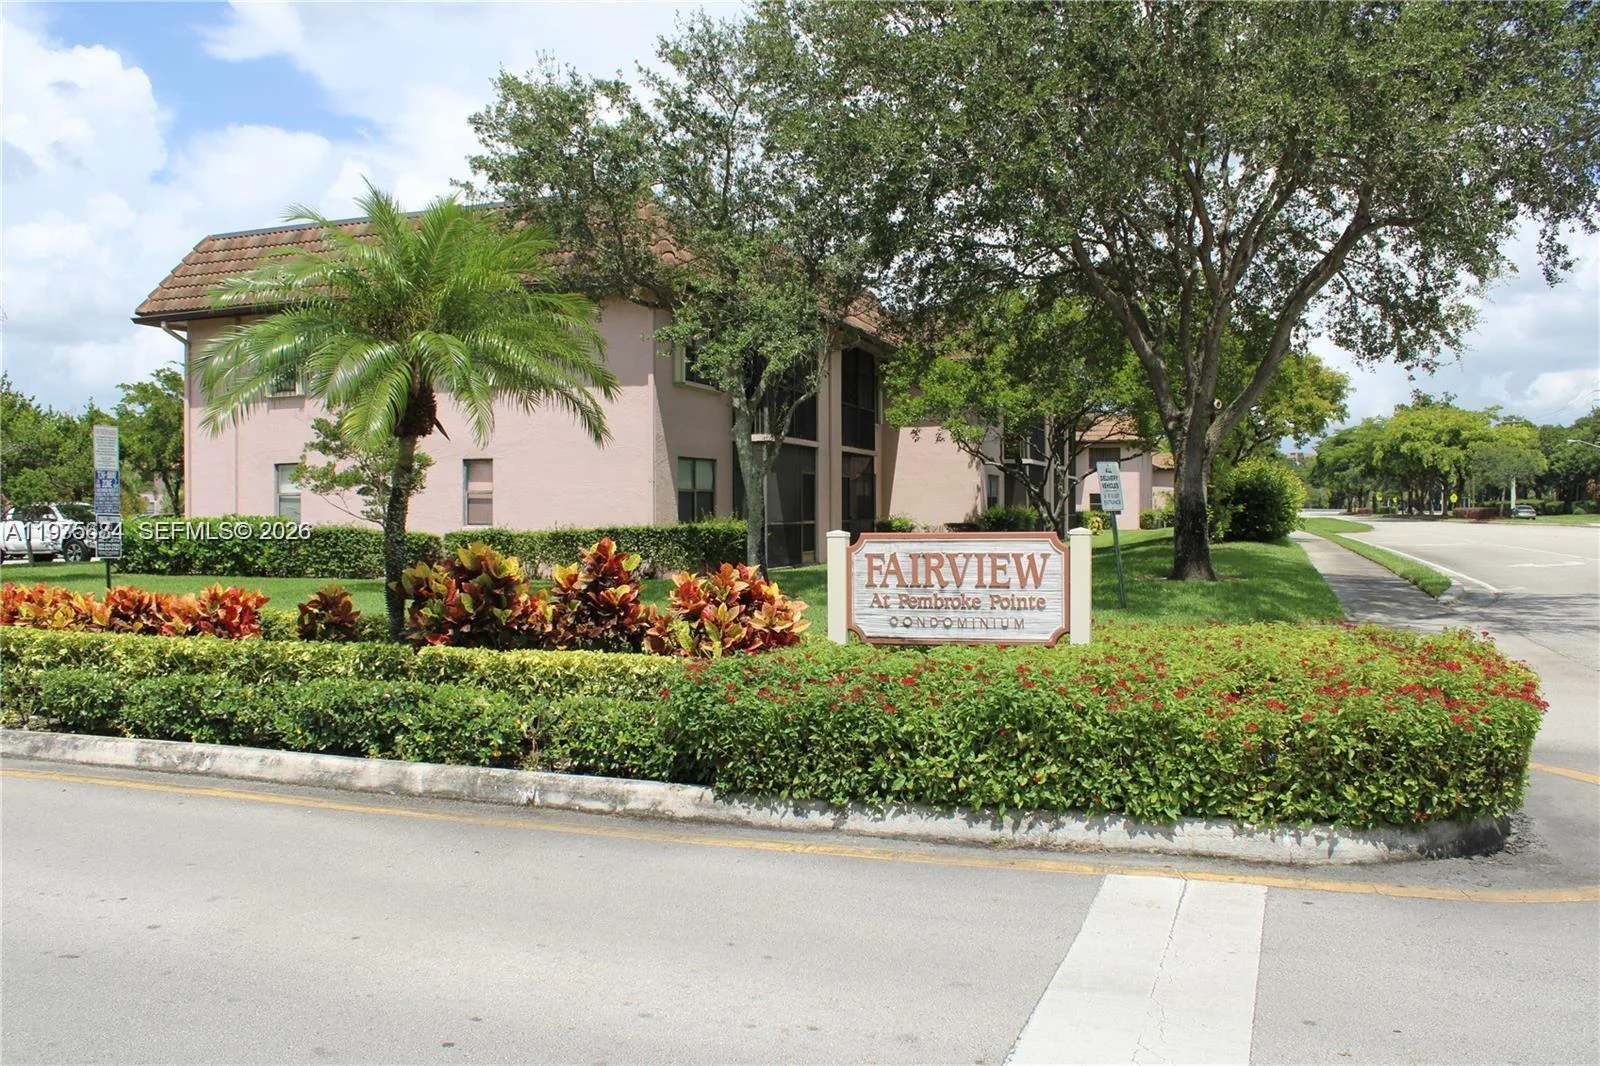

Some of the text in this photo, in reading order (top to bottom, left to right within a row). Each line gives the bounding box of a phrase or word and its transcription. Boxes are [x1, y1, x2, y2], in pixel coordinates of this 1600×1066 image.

[864, 552, 1051, 589] FAIRVIEW
[869, 592, 1046, 611] At Pembroke Pointe
[888, 616, 1025, 630] CONDOMINIUM
